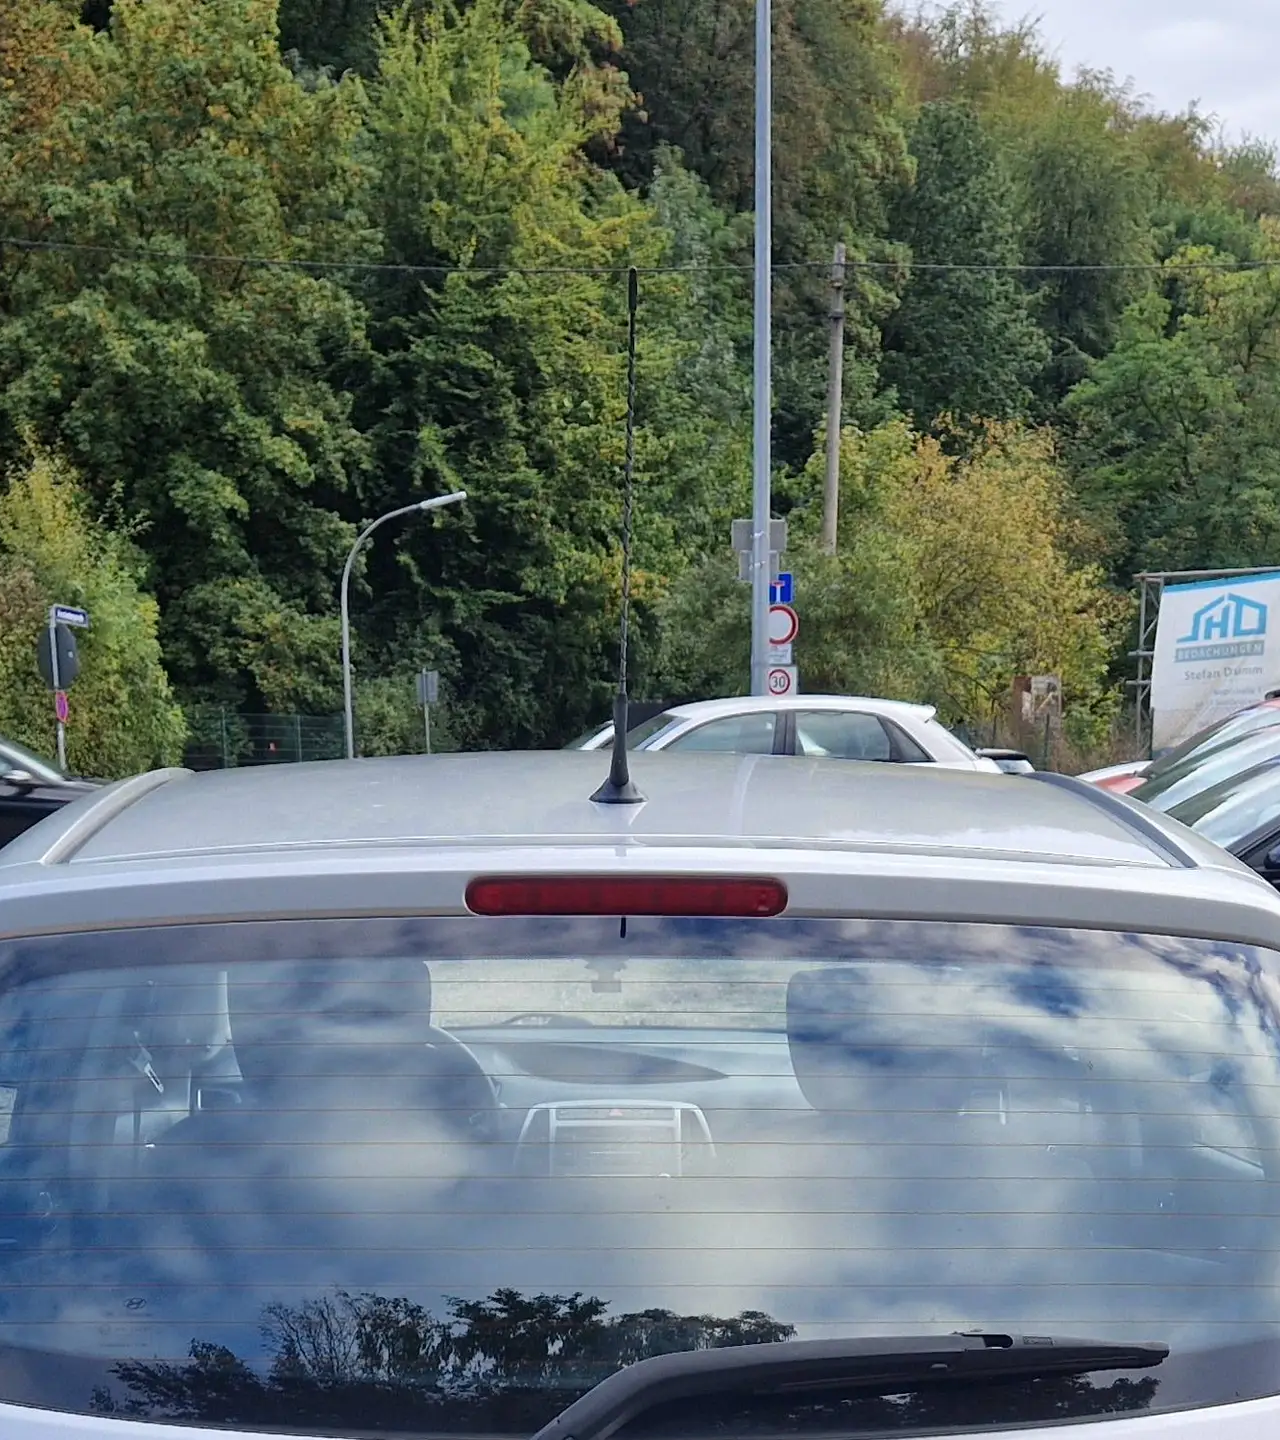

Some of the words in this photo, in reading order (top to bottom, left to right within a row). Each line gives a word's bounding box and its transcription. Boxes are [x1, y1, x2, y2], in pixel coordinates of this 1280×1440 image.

[1178, 642, 1263, 660] BEDACHUNGEN
[1184, 666, 1221, 681] Stefan
[771, 675, 786, 689] 30
